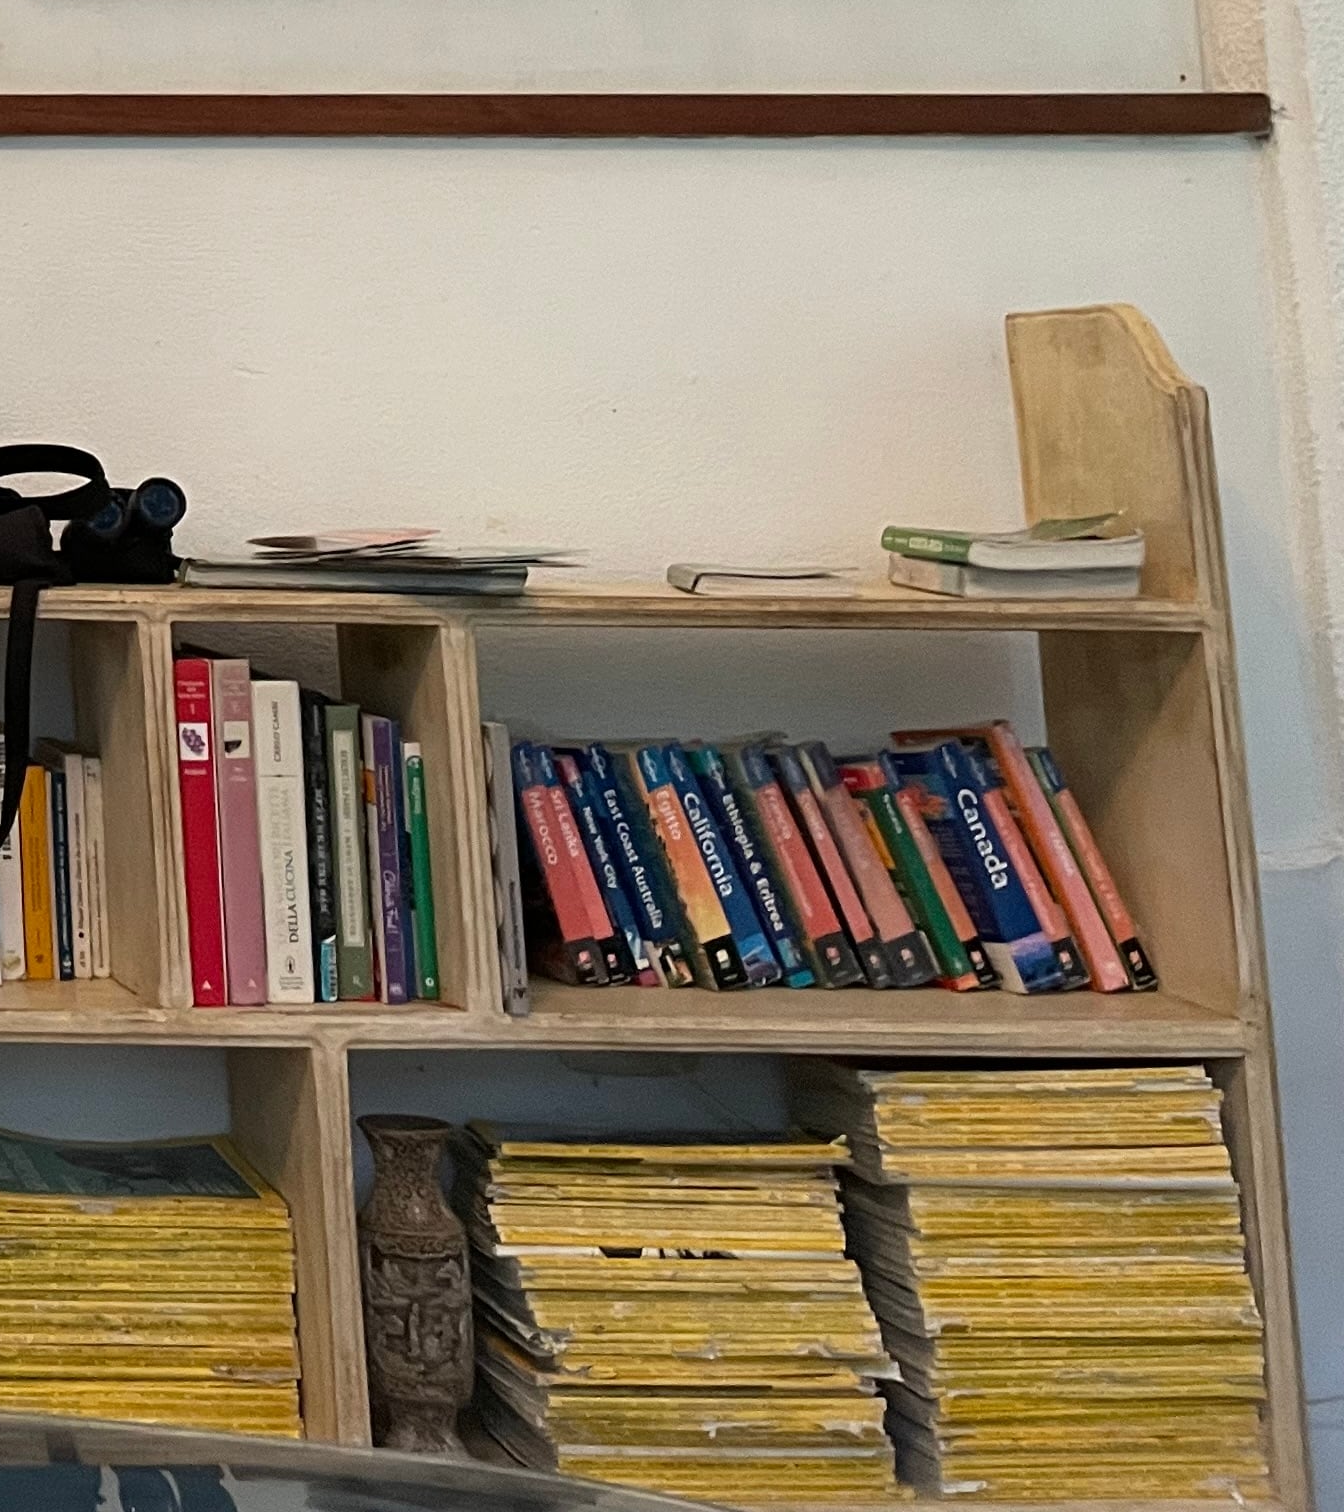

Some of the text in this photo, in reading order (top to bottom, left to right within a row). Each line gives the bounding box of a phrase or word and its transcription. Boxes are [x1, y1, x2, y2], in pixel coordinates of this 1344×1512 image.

[528, 791, 558, 866] Marocco
[550, 789, 581, 858] Sri Lanka
[582, 806, 619, 889] New York City
[603, 789, 663, 929] East Coast Australia
[657, 790, 682, 841] Egitto
[683, 792, 735, 898] California
[957, 788, 1009, 890] Canada
[284, 850, 299, 944] DELLA CUCINA
[722, 794, 785, 932] Ethiopia & Eritrea
